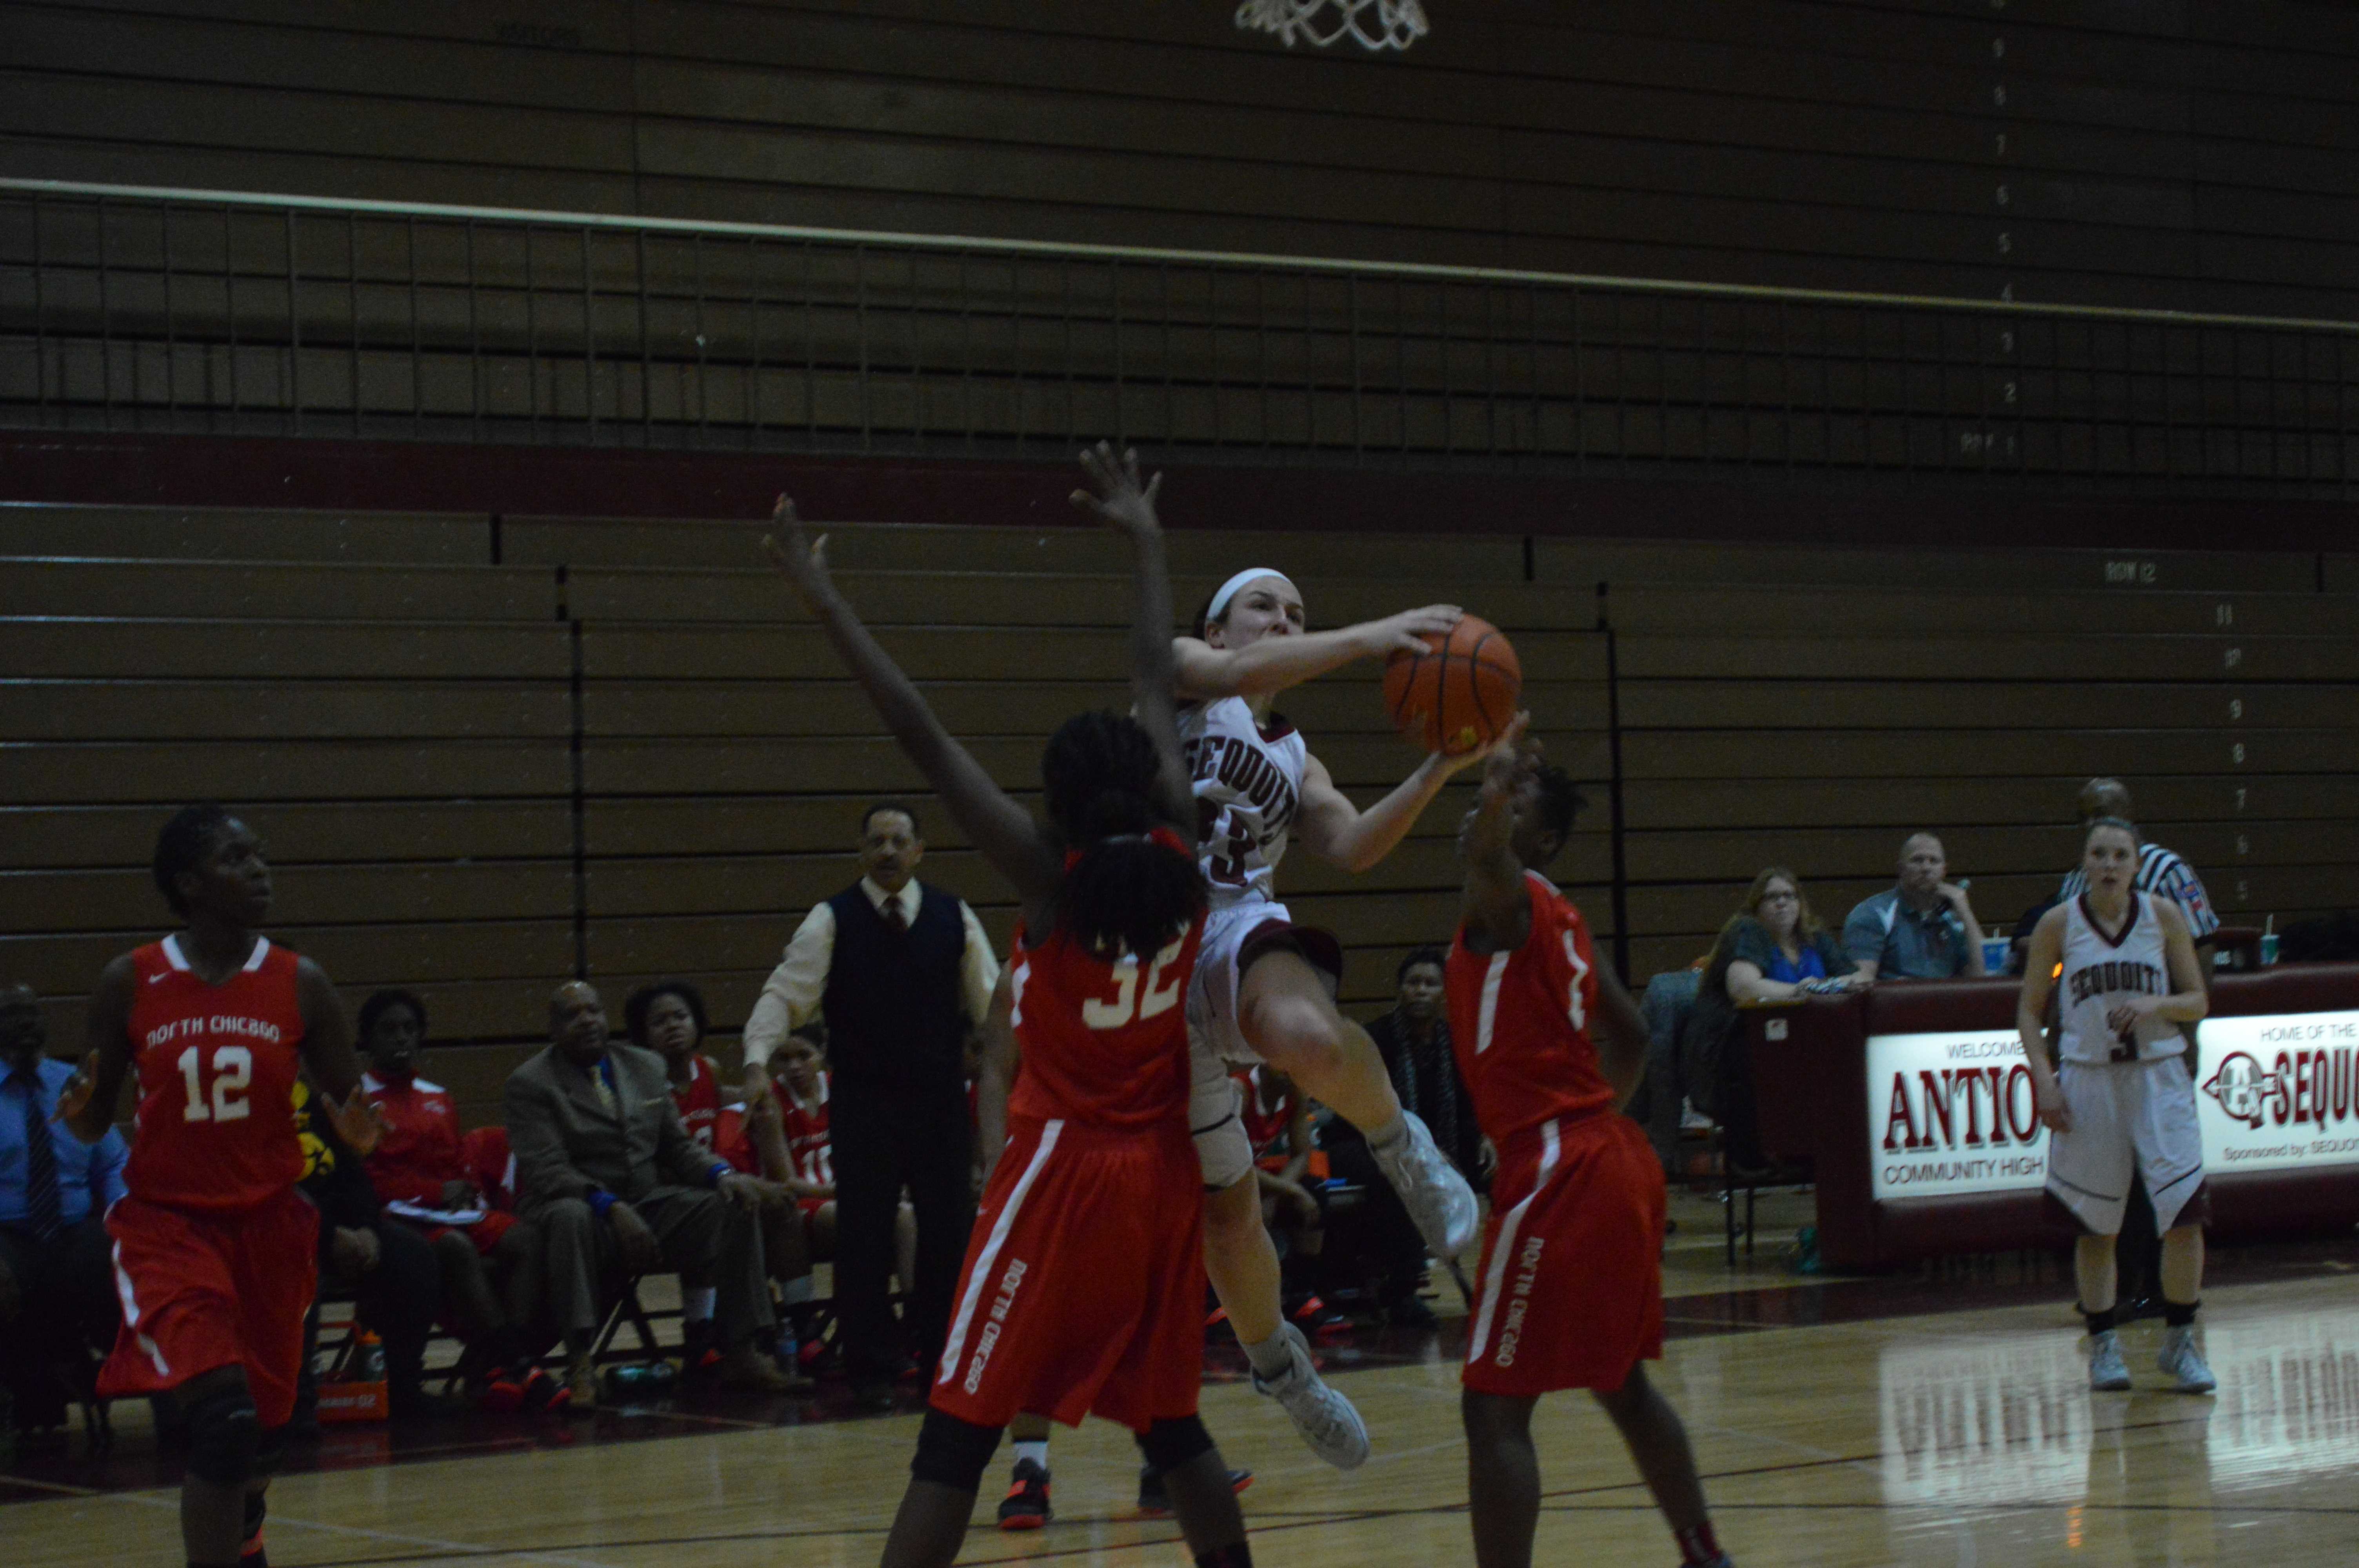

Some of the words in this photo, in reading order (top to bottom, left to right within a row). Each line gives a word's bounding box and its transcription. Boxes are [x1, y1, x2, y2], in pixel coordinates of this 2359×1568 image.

[2004, 381, 2017, 402] 2
[2105, 561, 2137, 582] ROW
[2139, 562, 2156, 583] 12
[2216, 604, 2232, 626] 11
[2230, 699, 2242, 719] 9
[1185, 735, 1296, 846] SEQUOIT
[2236, 789, 2247, 810] 7
[1081, 920, 1191, 1030] 32
[146, 1016, 204, 1050] NORTH
[210, 1015, 281, 1044] CHICAGO
[2261, 1027, 2304, 1042] HOME
[2307, 1025, 2326, 1040] OF
[2328, 1022, 2358, 1038] THE
[1946, 1040, 2026, 1060] WELCOME
[178, 1045, 253, 1124] 12
[2224, 1145, 2288, 1162] Sponsored
[1884, 1158, 1997, 1185] COMMUNITY
[2000, 1156, 2045, 1177] HIGH
